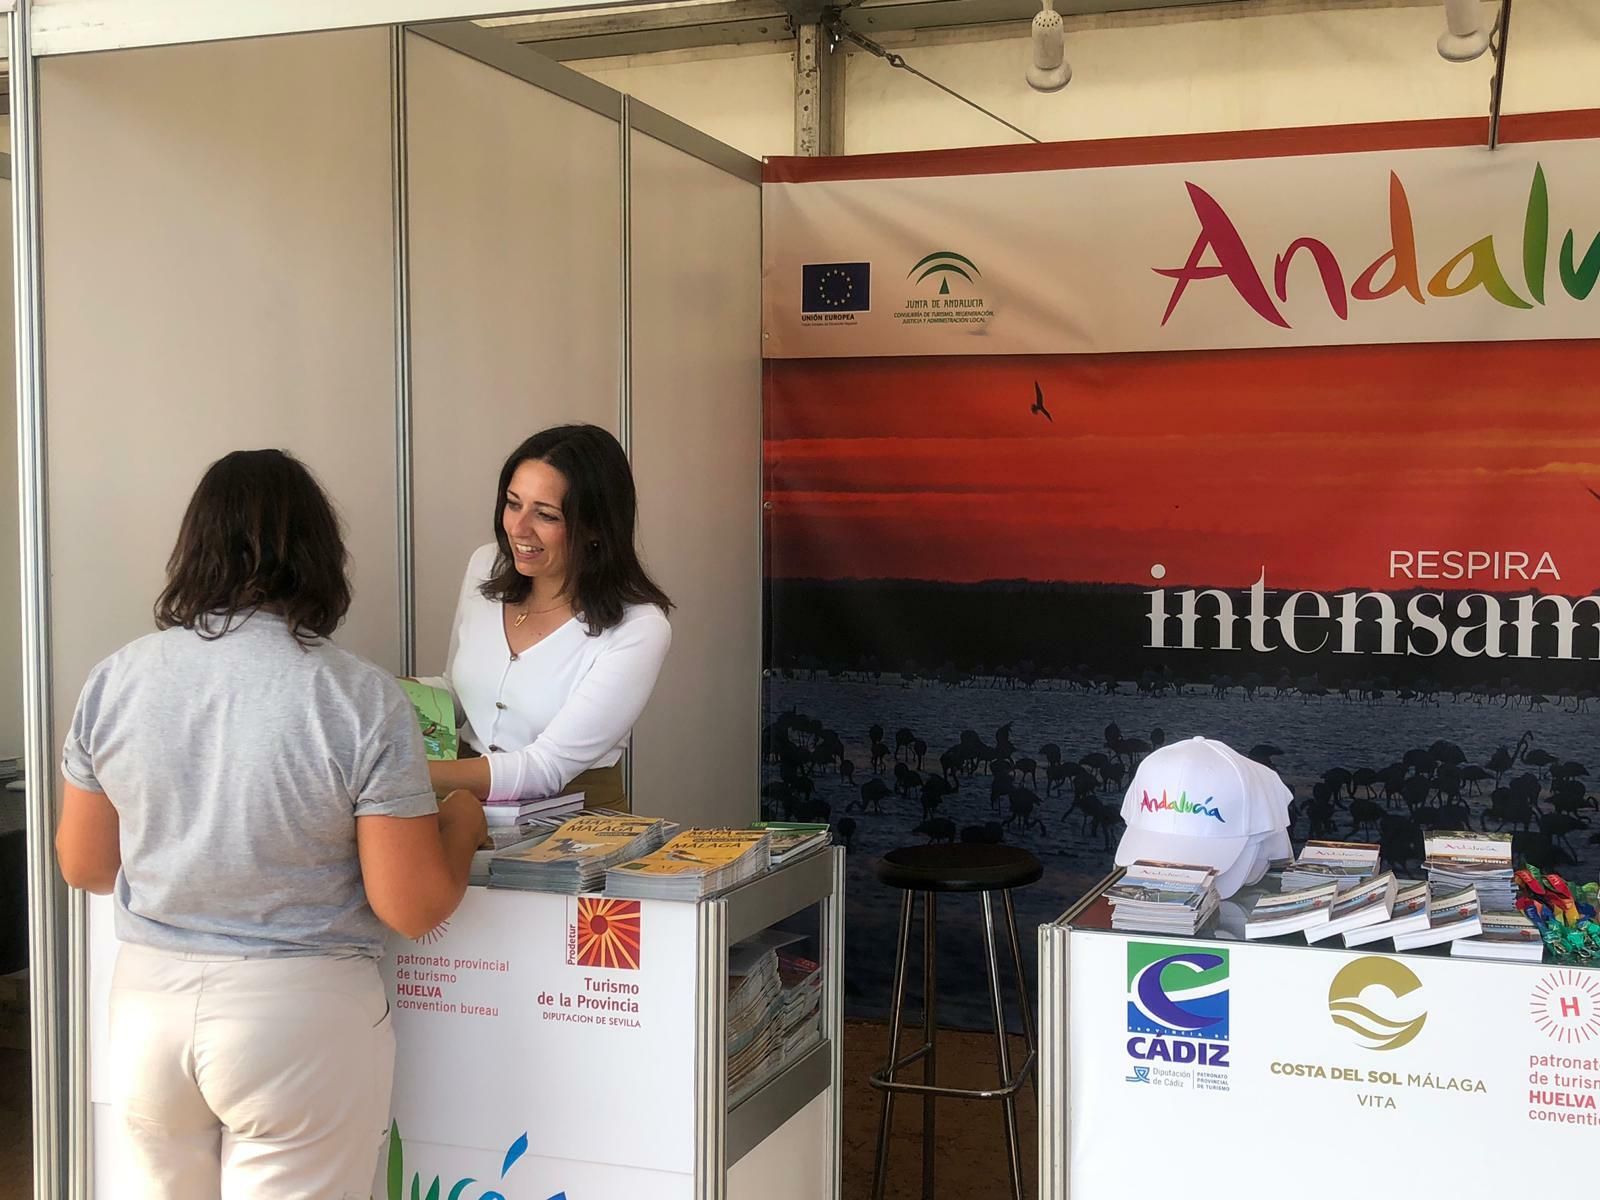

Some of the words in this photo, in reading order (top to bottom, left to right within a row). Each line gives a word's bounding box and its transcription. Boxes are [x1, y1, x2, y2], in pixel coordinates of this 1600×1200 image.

[1151, 161, 1600, 329] Andalu
[905, 299, 928, 308] JUNTA
[932, 299, 940, 308] DE
[802, 313, 823, 321] UNIÓN
[1389, 550, 1561, 581] RESPIRA
[1142, 563, 1600, 660] intensam
[1140, 788, 1226, 824] Andalucía
[568, 924, 576, 965] Prodetur
[396, 954, 450, 969] patronato
[454, 958, 510, 972] provincial
[396, 968, 410, 980] de
[414, 970, 457, 983] turismo
[396, 984, 442, 998] HUELVA
[584, 977, 640, 995] Turismo
[396, 999, 457, 1012] convention
[461, 1003, 499, 1016] bureau
[537, 992, 554, 1006] de
[560, 993, 572, 1007] la
[577, 995, 640, 1013] Provincia
[1560, 996, 1580, 1017] H
[596, 1016, 607, 1025] DE
[609, 1017, 641, 1028] SEVILLA
[1126, 1032, 1230, 1067] CÁDIZ
[1529, 1054, 1600, 1071] patronat
[1152, 1067, 1191, 1079] Diputación
[1197, 1071, 1228, 1079] PATRONATO
[1270, 1061, 1327, 1079] COSTA
[1331, 1066, 1364, 1083] DEL
[1368, 1070, 1402, 1086] SOL
[1407, 1072, 1487, 1093] MÁLAGA
[1529, 1071, 1548, 1085] de
[1152, 1077, 1161, 1085] de
[1164, 1078, 1185, 1088] Cádiz
[1206, 1084, 1230, 1092] TURISMO
[1357, 1094, 1396, 1109] VITA
[1529, 1090, 1597, 1109] HUELVA
[1529, 1109, 1600, 1126] conventi
